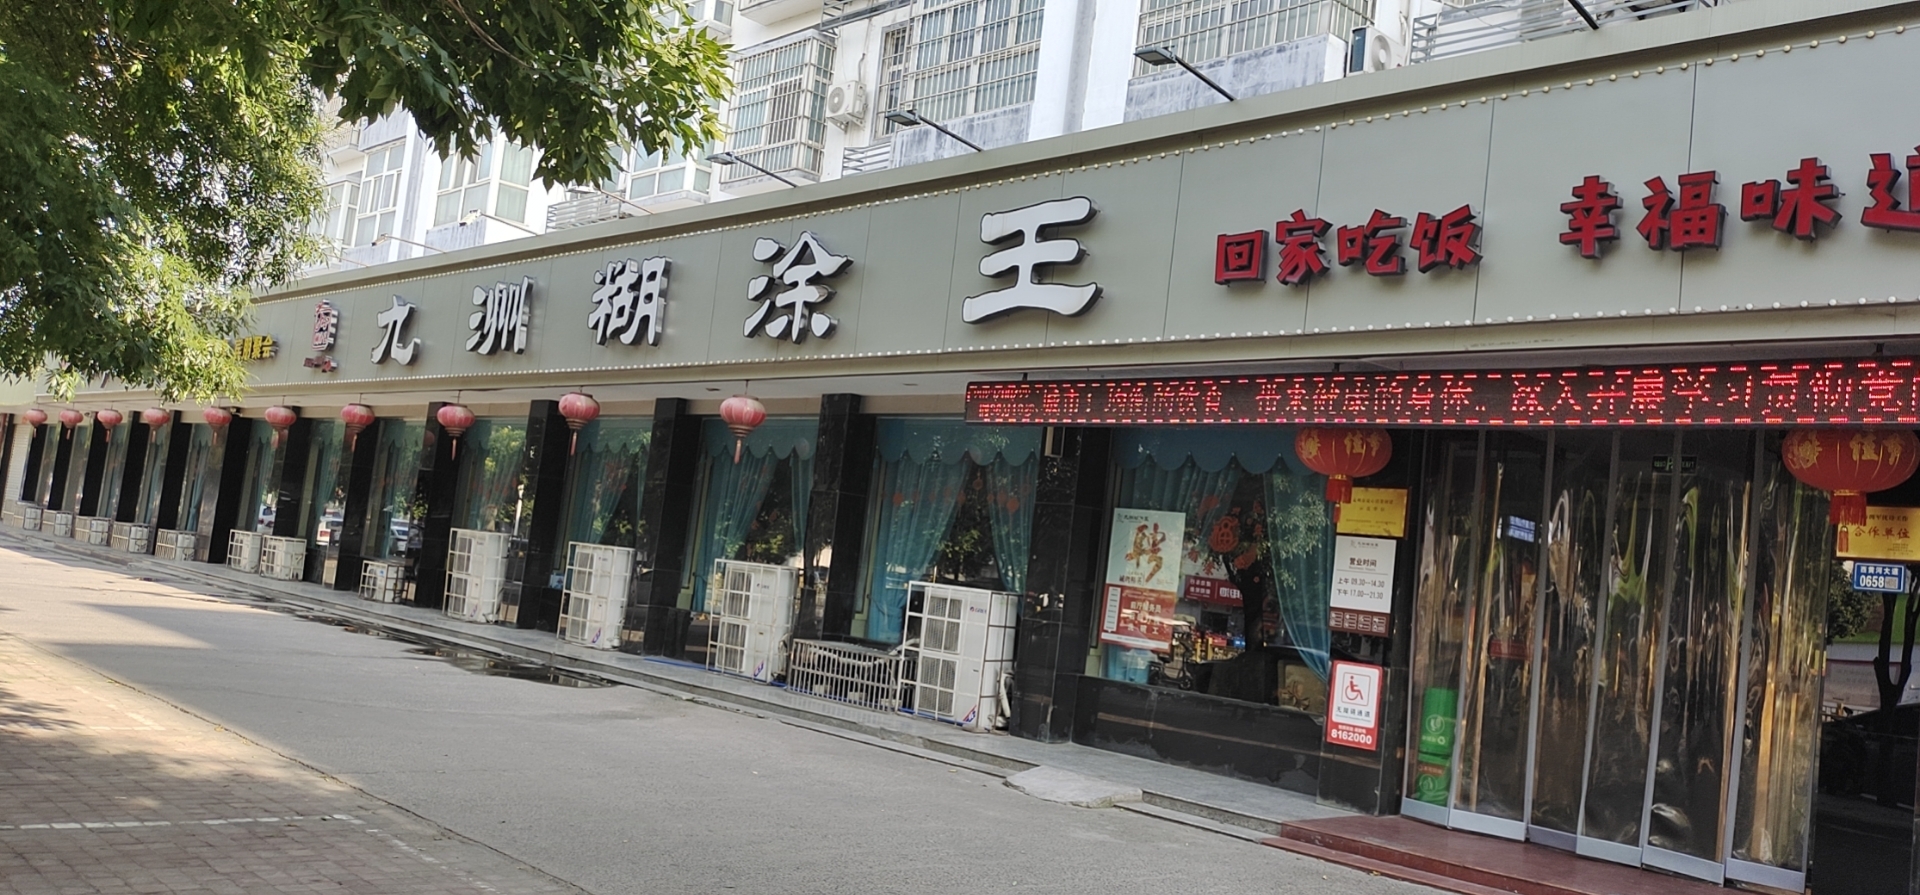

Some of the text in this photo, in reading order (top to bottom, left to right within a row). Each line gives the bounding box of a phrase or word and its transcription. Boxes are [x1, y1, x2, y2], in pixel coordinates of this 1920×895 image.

[1214, 204, 1484, 286] 回家吃饭
[370, 195, 1104, 366] 九洲糊涂王
[1852, 525, 1911, 540] 合作单位
[1349, 557, 1377, 567] 营业时间
[1860, 565, 1899, 576] 西黄河大道
[1337, 577, 1350, 585] 上午
[1859, 574, 1885, 588] 0658
[1336, 588, 1349, 596] 下午
[1336, 706, 1371, 718] 无障碍通道
[1331, 729, 1372, 745] 8162000
